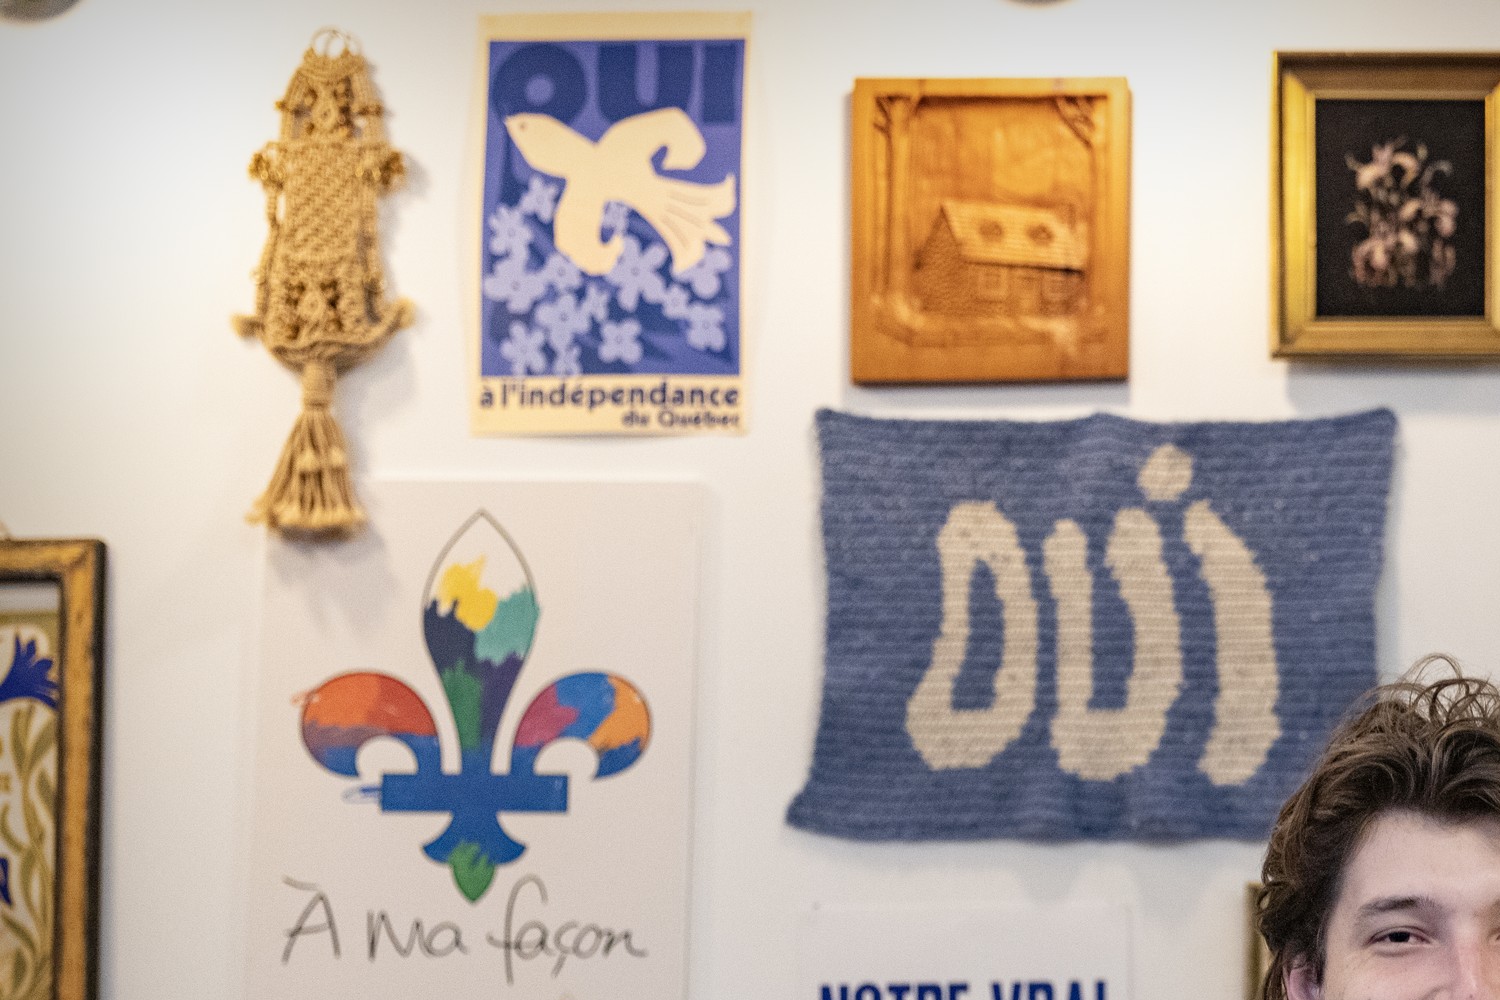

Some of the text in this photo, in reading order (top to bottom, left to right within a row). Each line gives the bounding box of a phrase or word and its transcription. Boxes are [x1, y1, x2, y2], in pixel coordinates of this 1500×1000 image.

[492, 42, 737, 128] OUI
[502, 381, 740, 413] l'indépendance
[281, 875, 341, 964] À
[486, 874, 648, 985] façon
